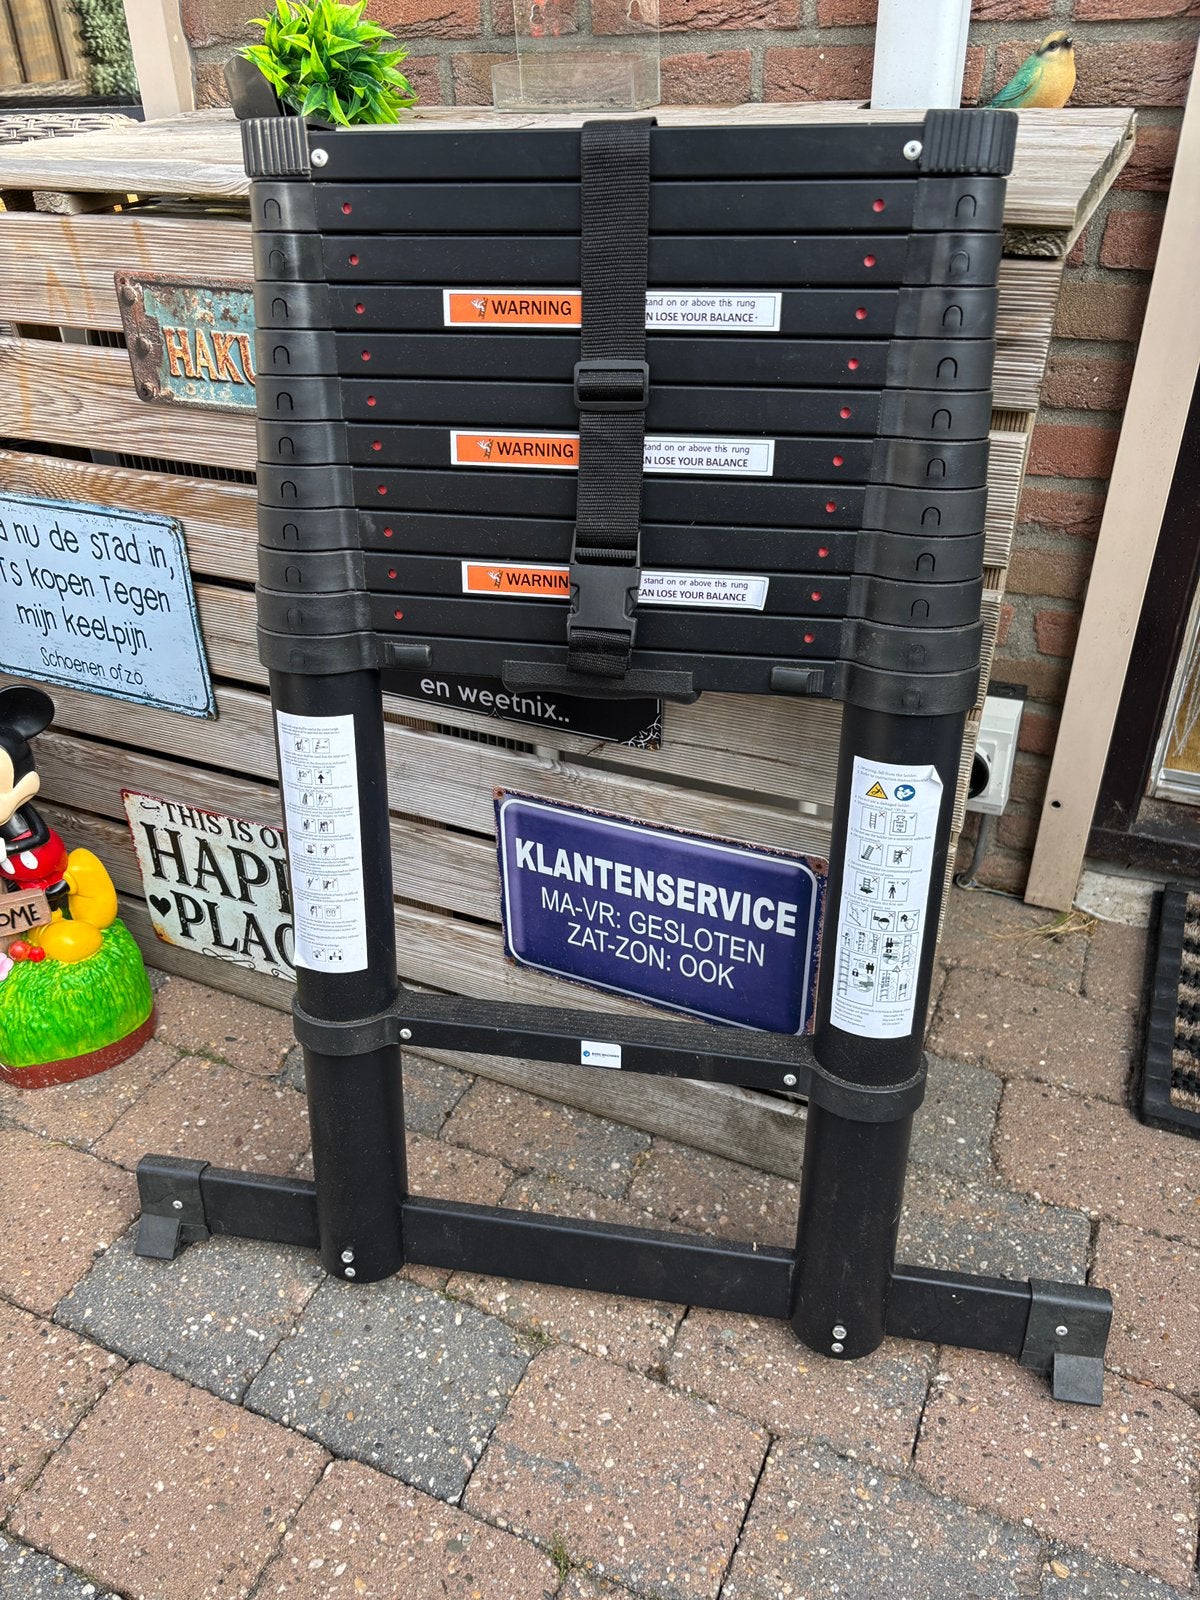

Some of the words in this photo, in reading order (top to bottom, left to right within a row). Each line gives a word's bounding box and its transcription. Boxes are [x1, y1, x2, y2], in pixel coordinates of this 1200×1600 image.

[491, 299, 572, 317] WARNING
[644, 298, 664, 307] tand
[666, 299, 677, 307] on
[680, 299, 689, 307] or
[691, 298, 716, 307] above
[719, 298, 733, 307] this
[736, 300, 756, 309] rung
[656, 312, 679, 322] LOSE
[681, 312, 709, 322] YOUR
[710, 313, 754, 323] BALANCE
[497, 441, 574, 458] WARNING
[644, 442, 662, 451] tand
[664, 443, 675, 451] on
[677, 444, 686, 452] or
[688, 443, 712, 452] above
[714, 444, 728, 453] this
[731, 446, 750, 455] rung
[654, 456, 676, 465] LOSE
[678, 457, 704, 466] YOUR
[706, 458, 749, 467] BALANCE
[12, 521, 41, 549] nu
[49, 521, 80, 554] de
[147, 539, 175, 581] in,
[26, 558, 95, 601] kopen
[506, 571, 569, 589] WARNIN
[643, 577, 664, 585] stand
[689, 579, 712, 587] above
[714, 580, 727, 588] this
[730, 582, 749, 590] rung
[638, 588, 654, 597] CAN
[656, 589, 678, 598] LOSE
[679, 590, 704, 600] YOUR
[706, 591, 747, 602] BALANCE
[16, 602, 58, 637] mijn
[39, 646, 106, 678] Schoenen
[419, 677, 451, 698] en
[457, 684, 570, 723] weetnix..
[160, 800, 223, 836] THIS
[223, 818, 254, 843] IS
[514, 837, 799, 938] KLANTENSERVICE
[540, 886, 622, 929] MA-VR:
[628, 910, 766, 967] GESLOTEN
[567, 921, 672, 973] ZAT-ZON:
[678, 952, 736, 990] OOK
